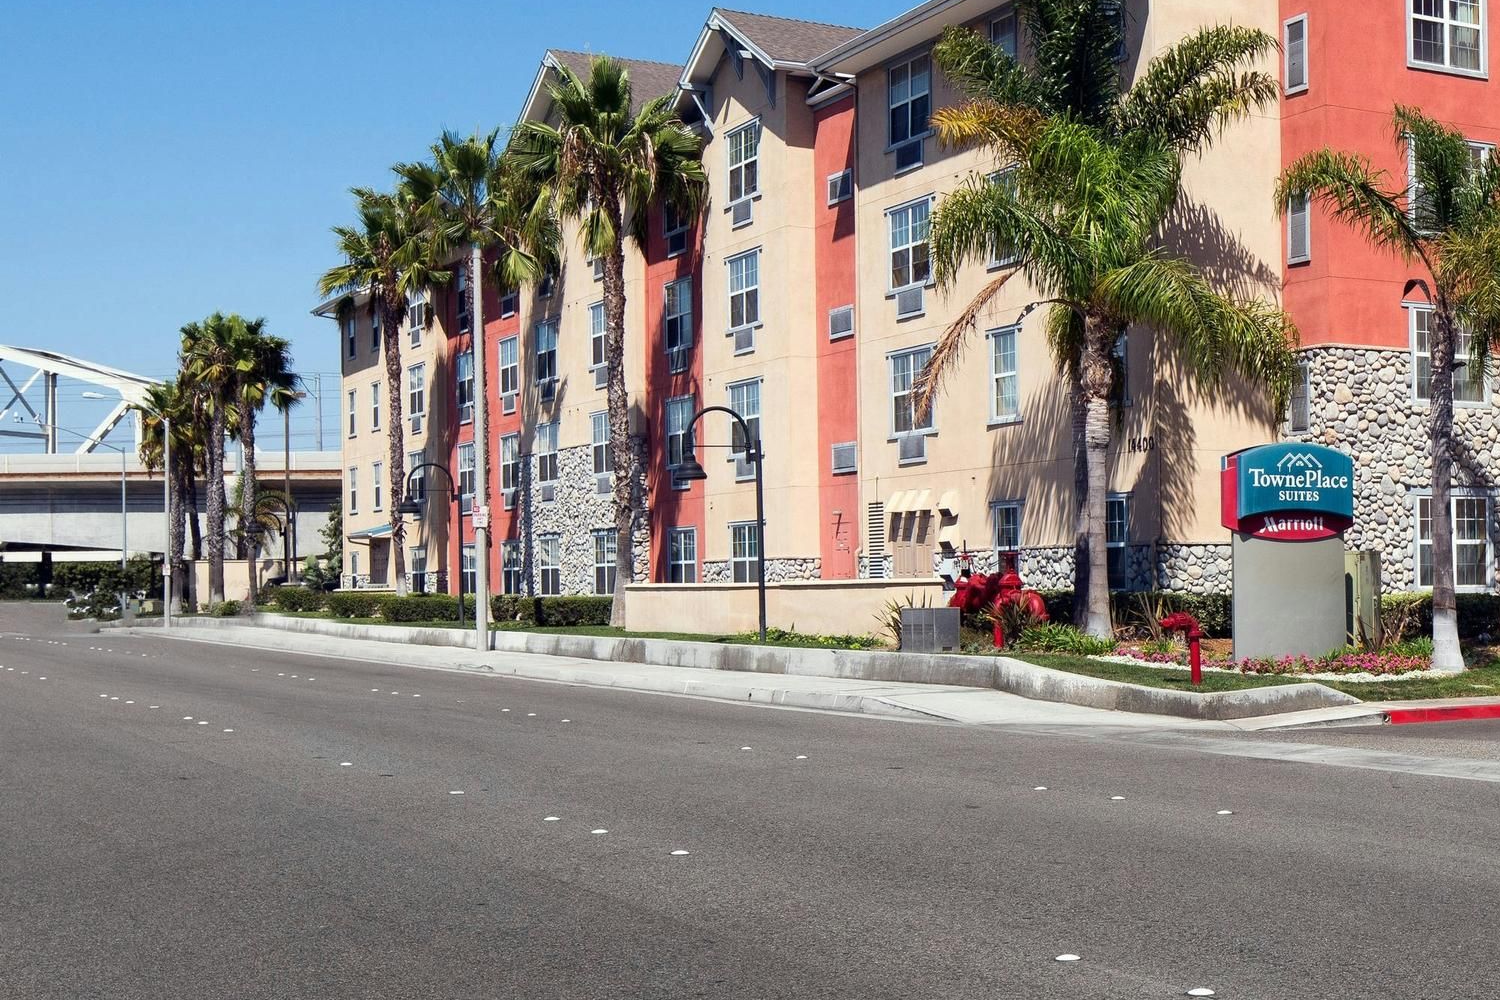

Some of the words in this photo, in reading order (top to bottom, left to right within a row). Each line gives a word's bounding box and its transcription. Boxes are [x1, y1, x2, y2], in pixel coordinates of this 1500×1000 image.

[1128, 436, 1154, 454] 14400
[1248, 468, 1348, 489] TownePlace
[1278, 490, 1320, 502] SUITES
[1259, 515, 1324, 534] Marriott
